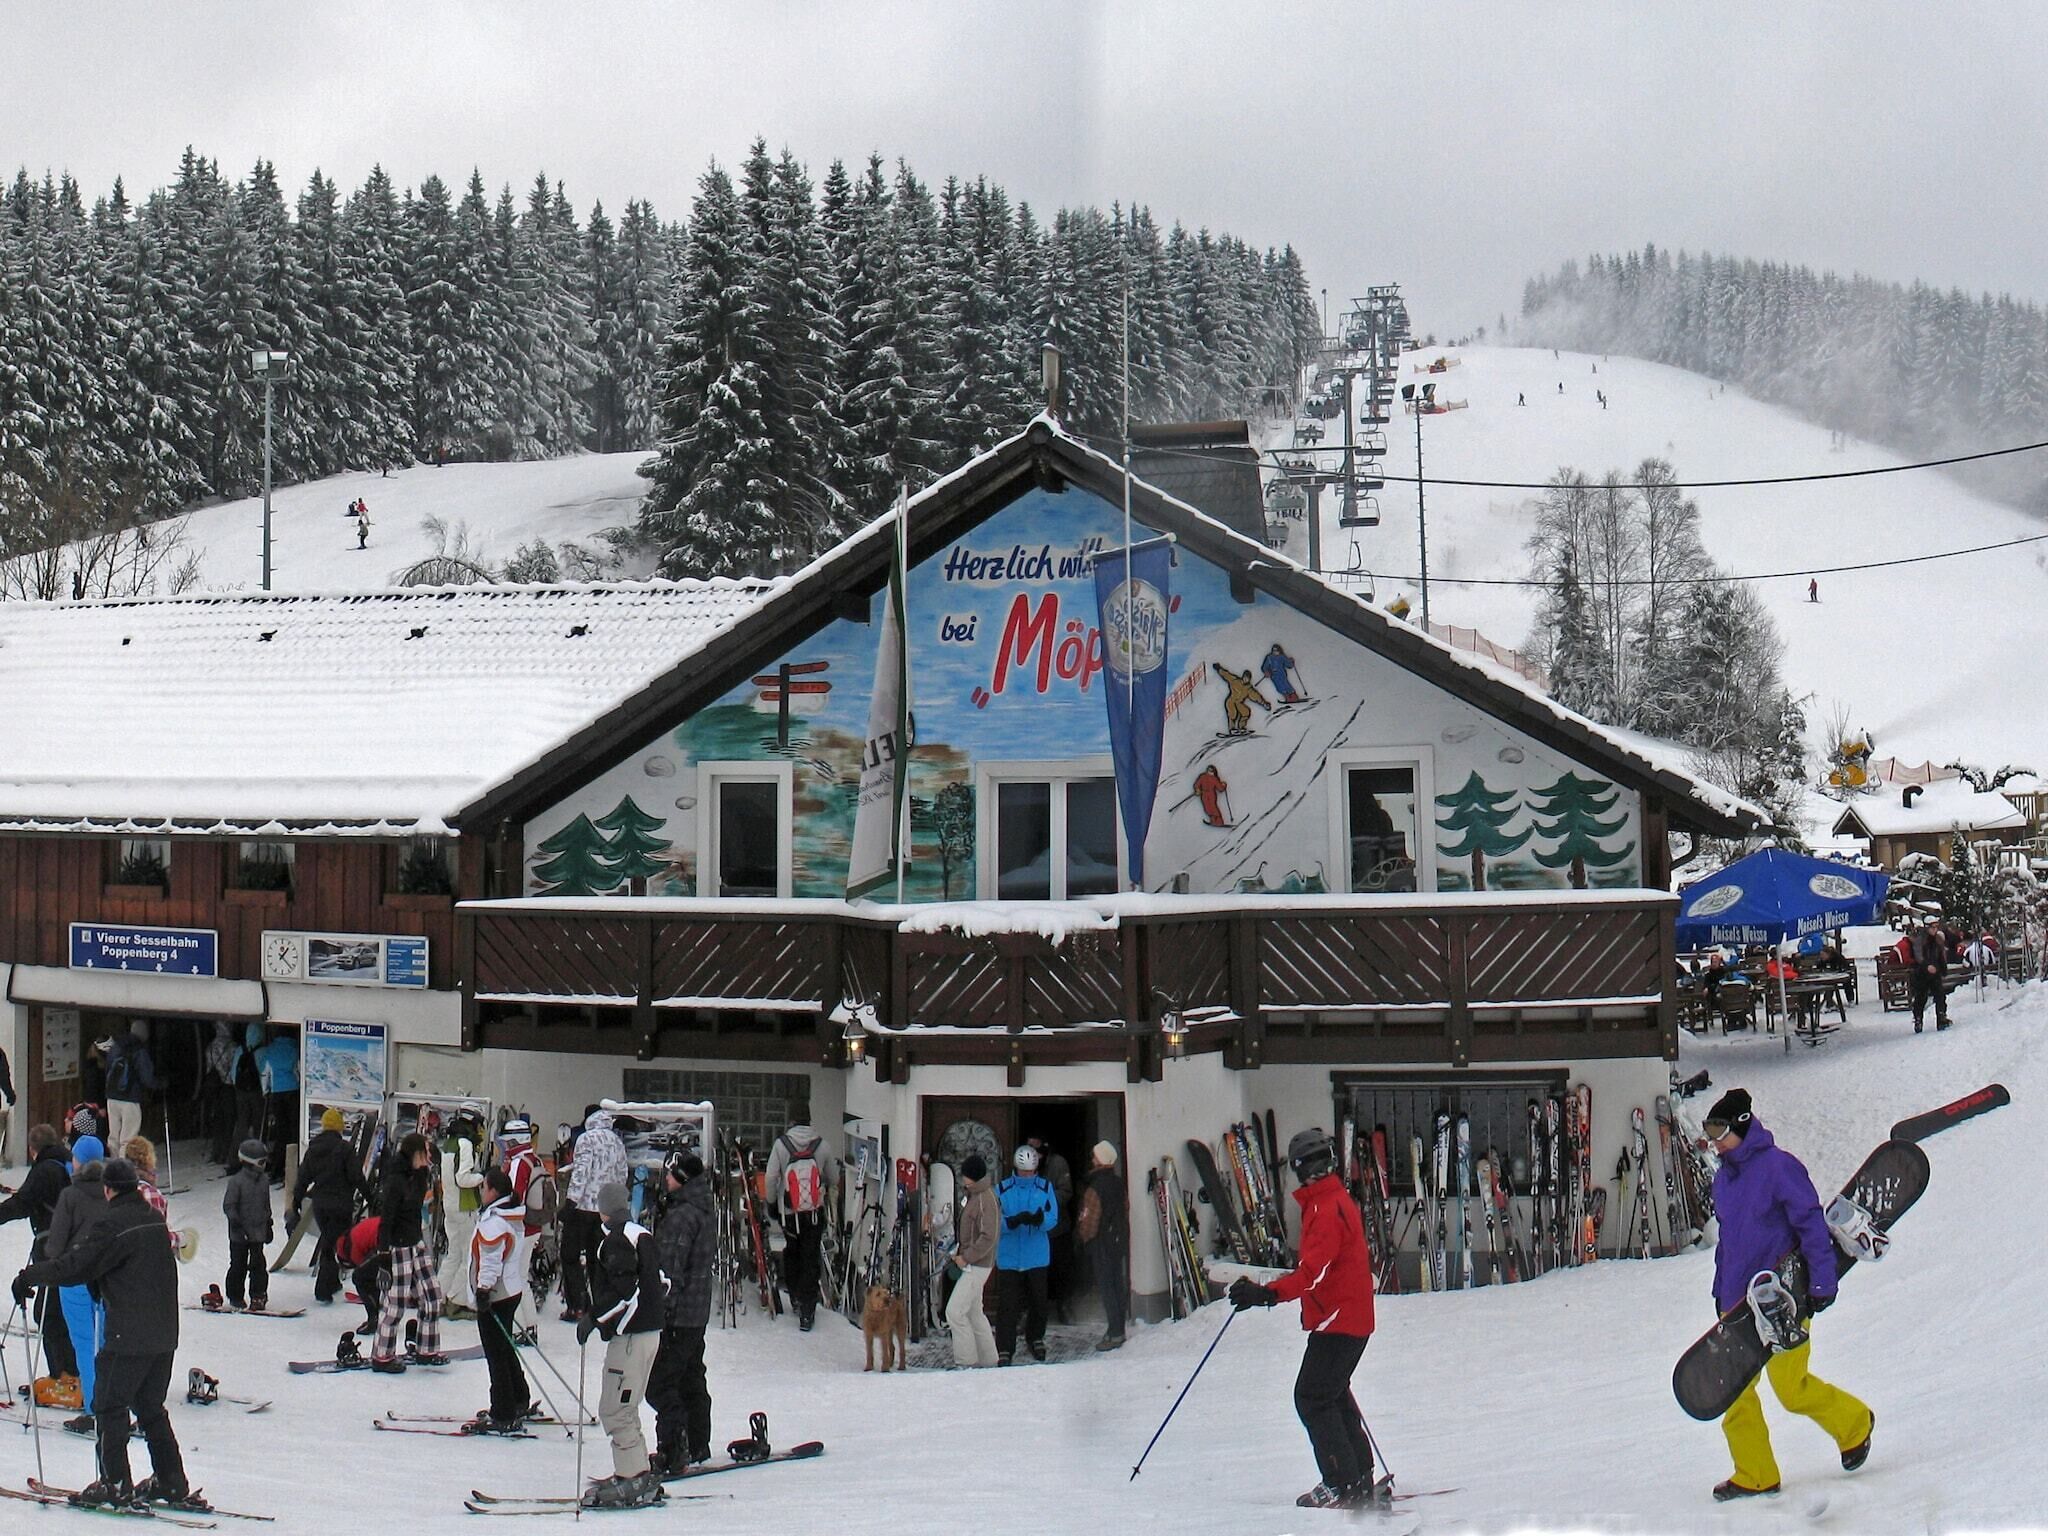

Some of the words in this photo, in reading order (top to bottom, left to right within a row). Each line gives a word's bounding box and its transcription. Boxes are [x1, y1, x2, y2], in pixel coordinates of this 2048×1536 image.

[945, 545, 1054, 581] Herzlich
[941, 615, 977, 641] bei
[1824, 910, 1849, 930] Weisse
[96, 932, 131, 944] Vierer
[133, 934, 199, 948] Sesselbahn
[1711, 925, 1740, 943] Maisel's
[1742, 925, 1767, 943] Weisse
[102, 945, 168, 961] Poppenberg
[170, 949, 178, 960] 4
[321, 1022, 366, 1034] Poppenberg
